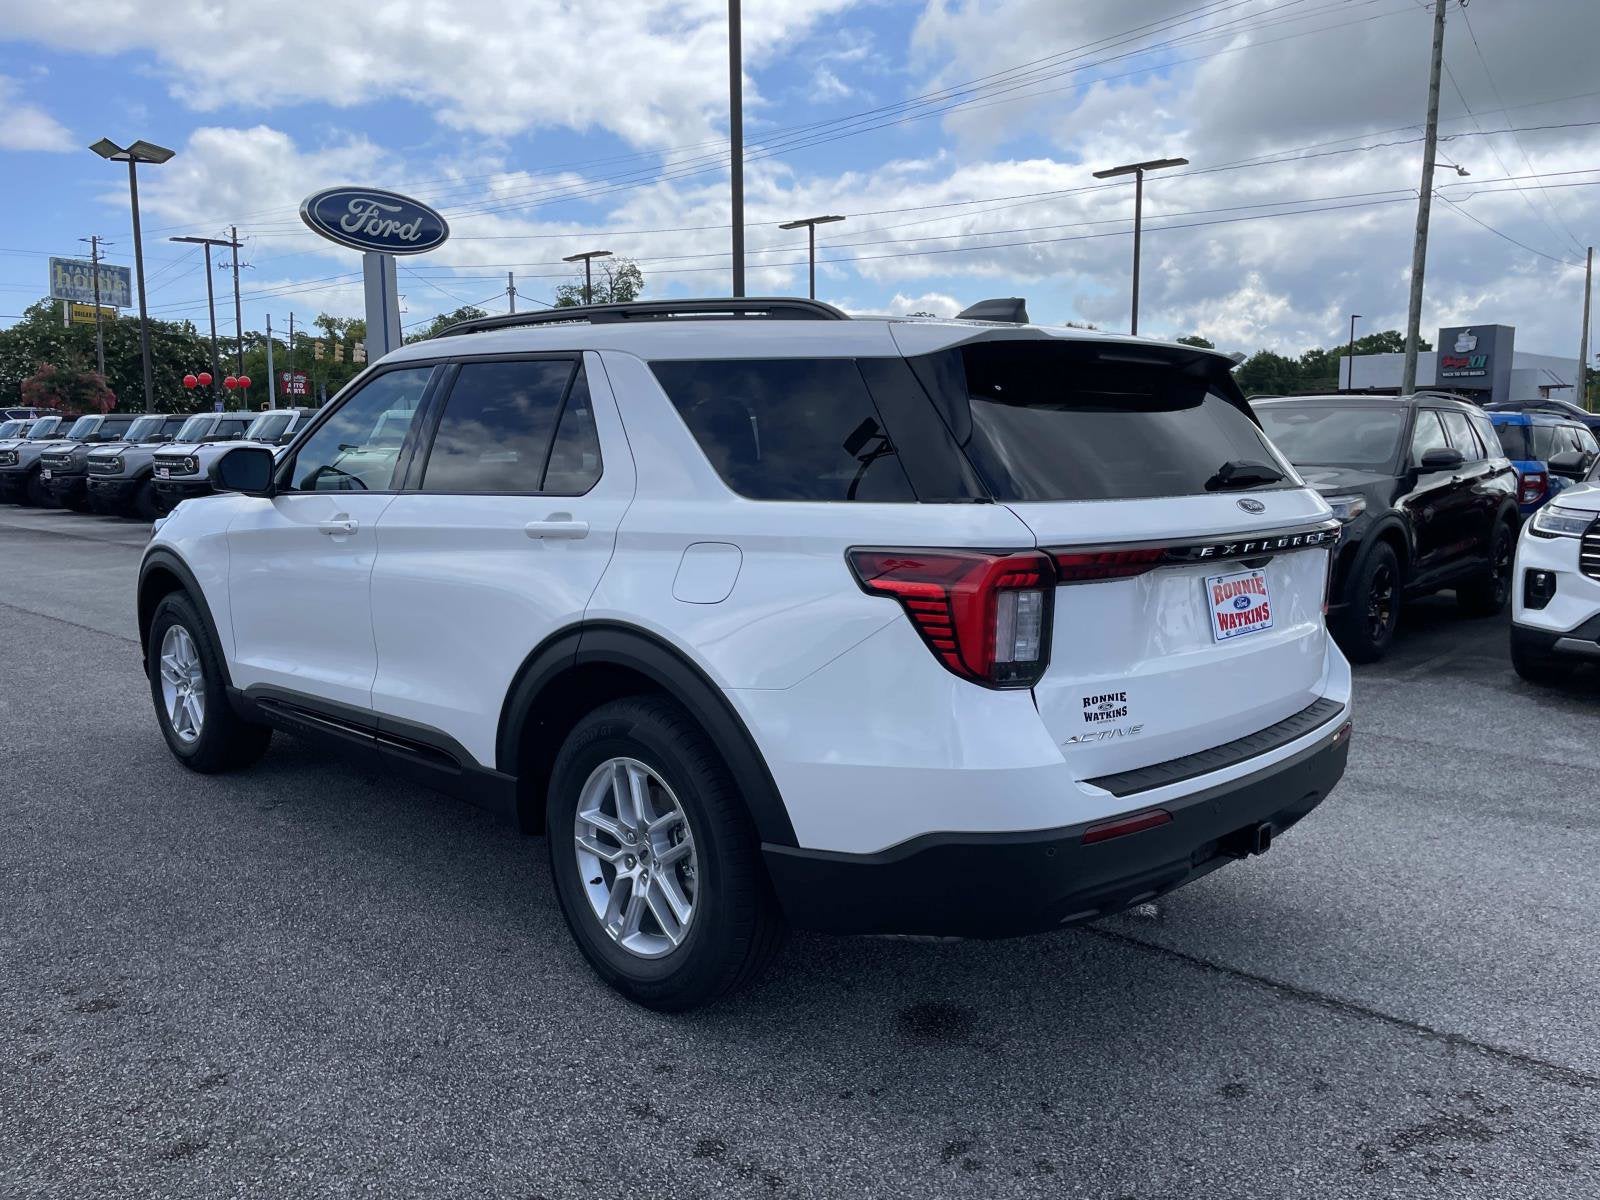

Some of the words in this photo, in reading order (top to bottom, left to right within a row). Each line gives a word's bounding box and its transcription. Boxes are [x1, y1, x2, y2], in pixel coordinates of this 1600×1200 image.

[340, 198, 423, 241] Ford
[1213, 576, 1266, 606] RONNIE
[1217, 602, 1269, 631] WATKINS
[1083, 691, 1127, 708] RONNIE
[1083, 705, 1127, 722] WATKINS
[1062, 724, 1144, 745] ACTIVE
